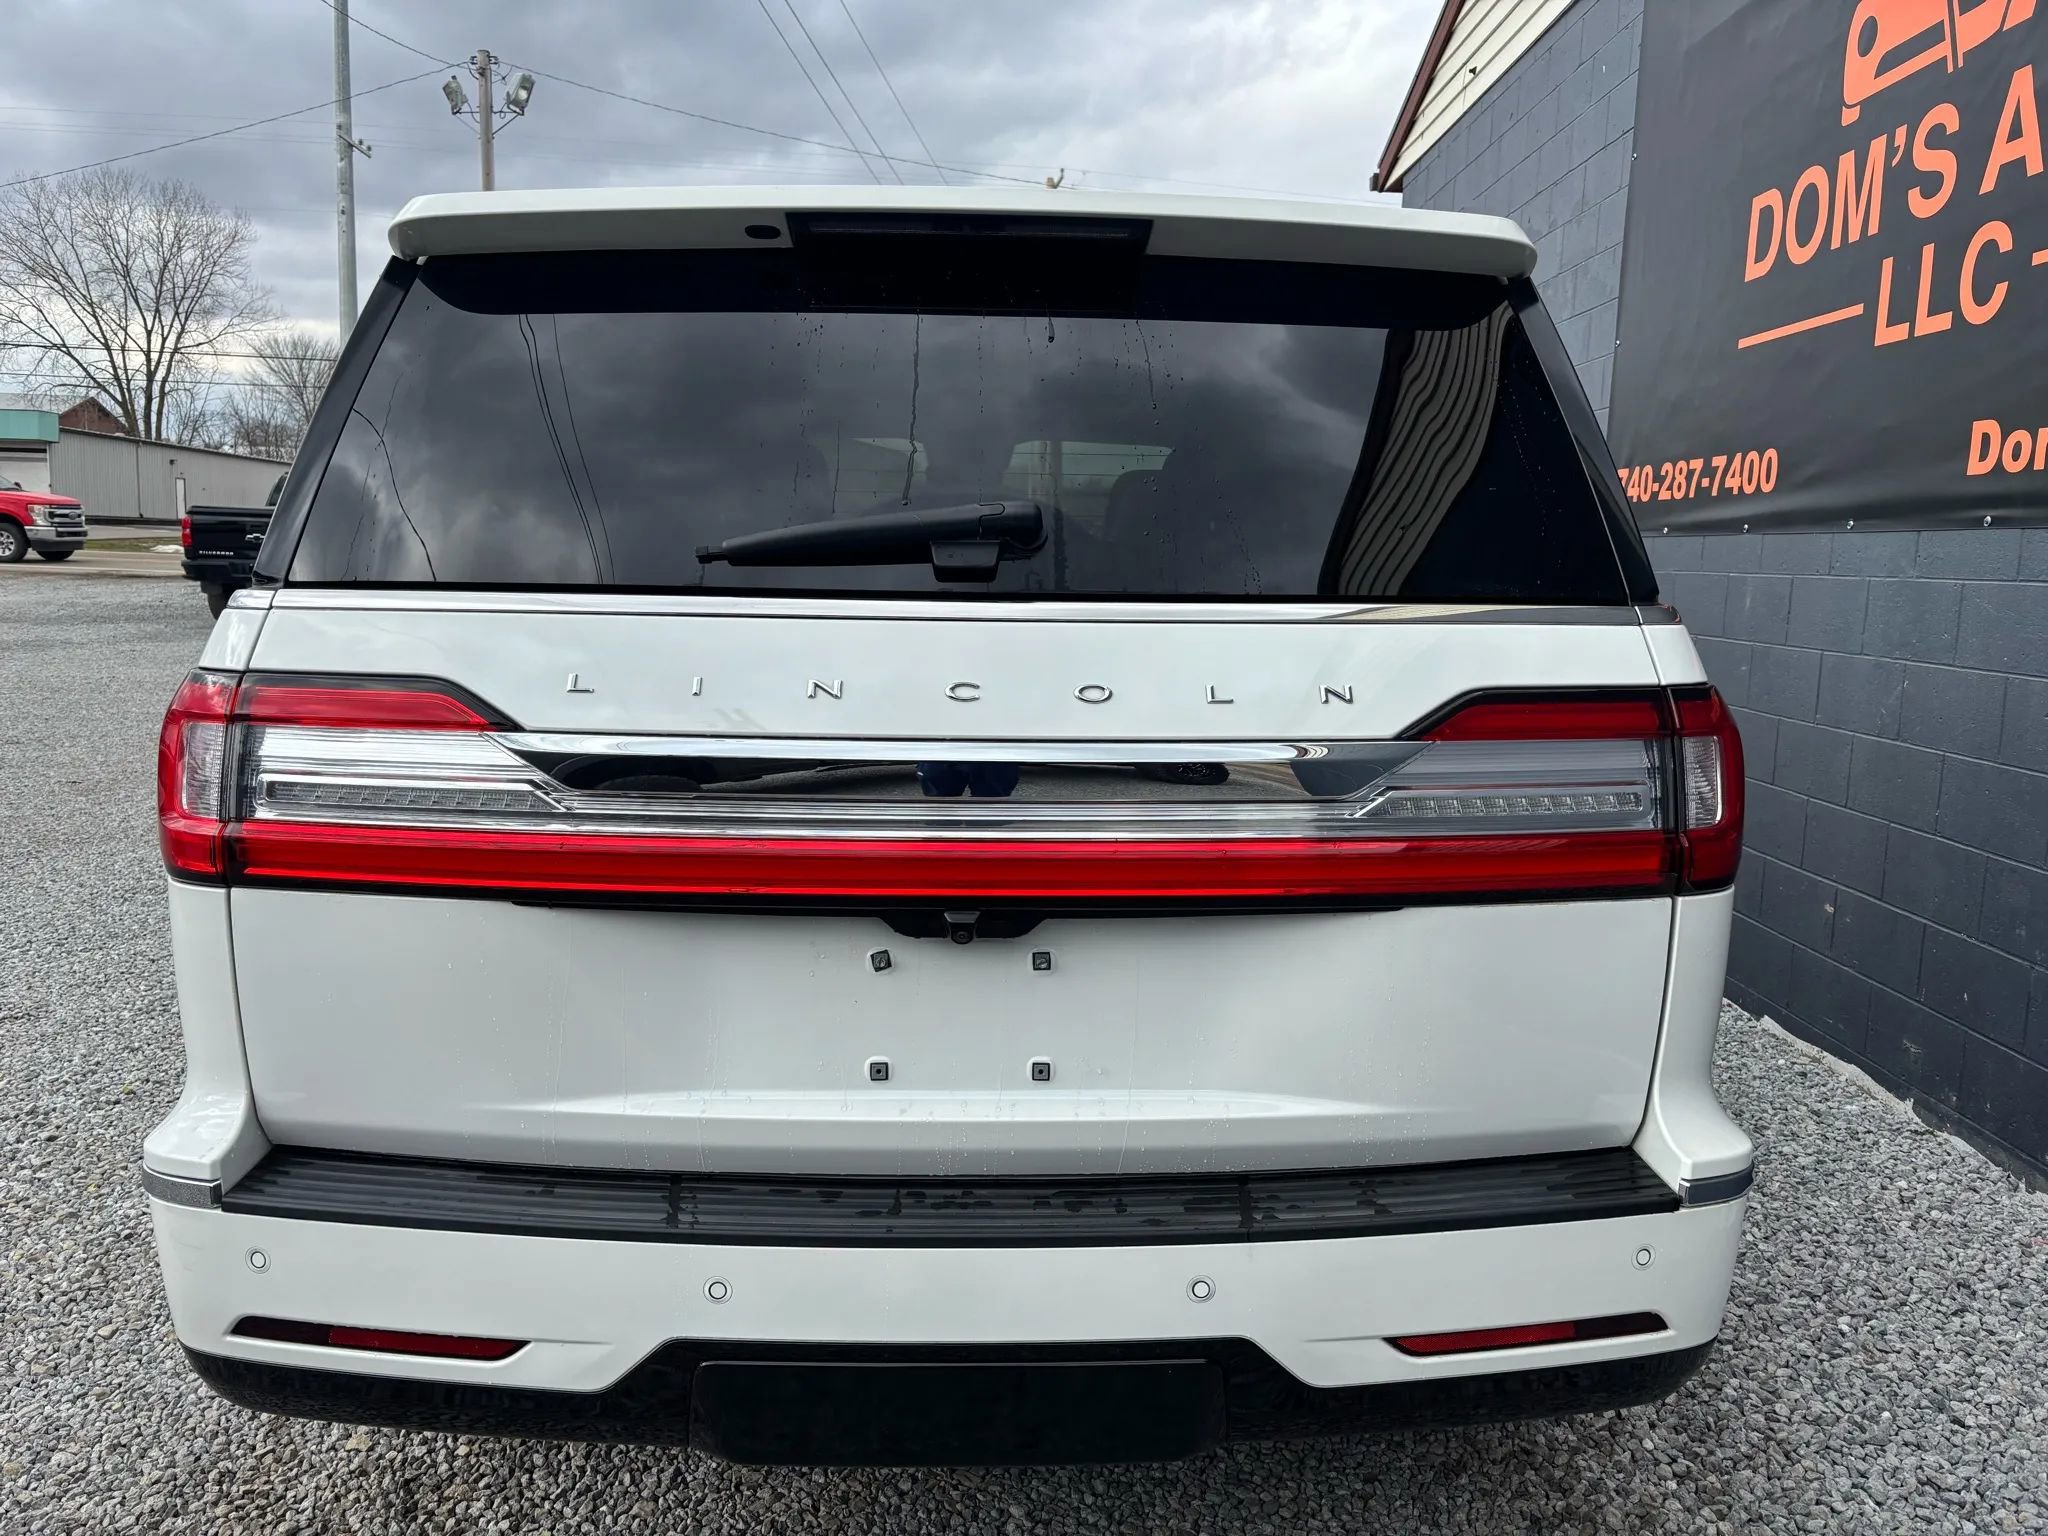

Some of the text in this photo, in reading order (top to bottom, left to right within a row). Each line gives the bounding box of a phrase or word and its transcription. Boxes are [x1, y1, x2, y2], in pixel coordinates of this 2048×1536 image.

[1744, 102, 1960, 282] DOM'S
[1874, 220, 2013, 347] LLC
[1617, 448, 1779, 503] 740-287-7400
[566, 672, 1354, 706] LINCOLN
